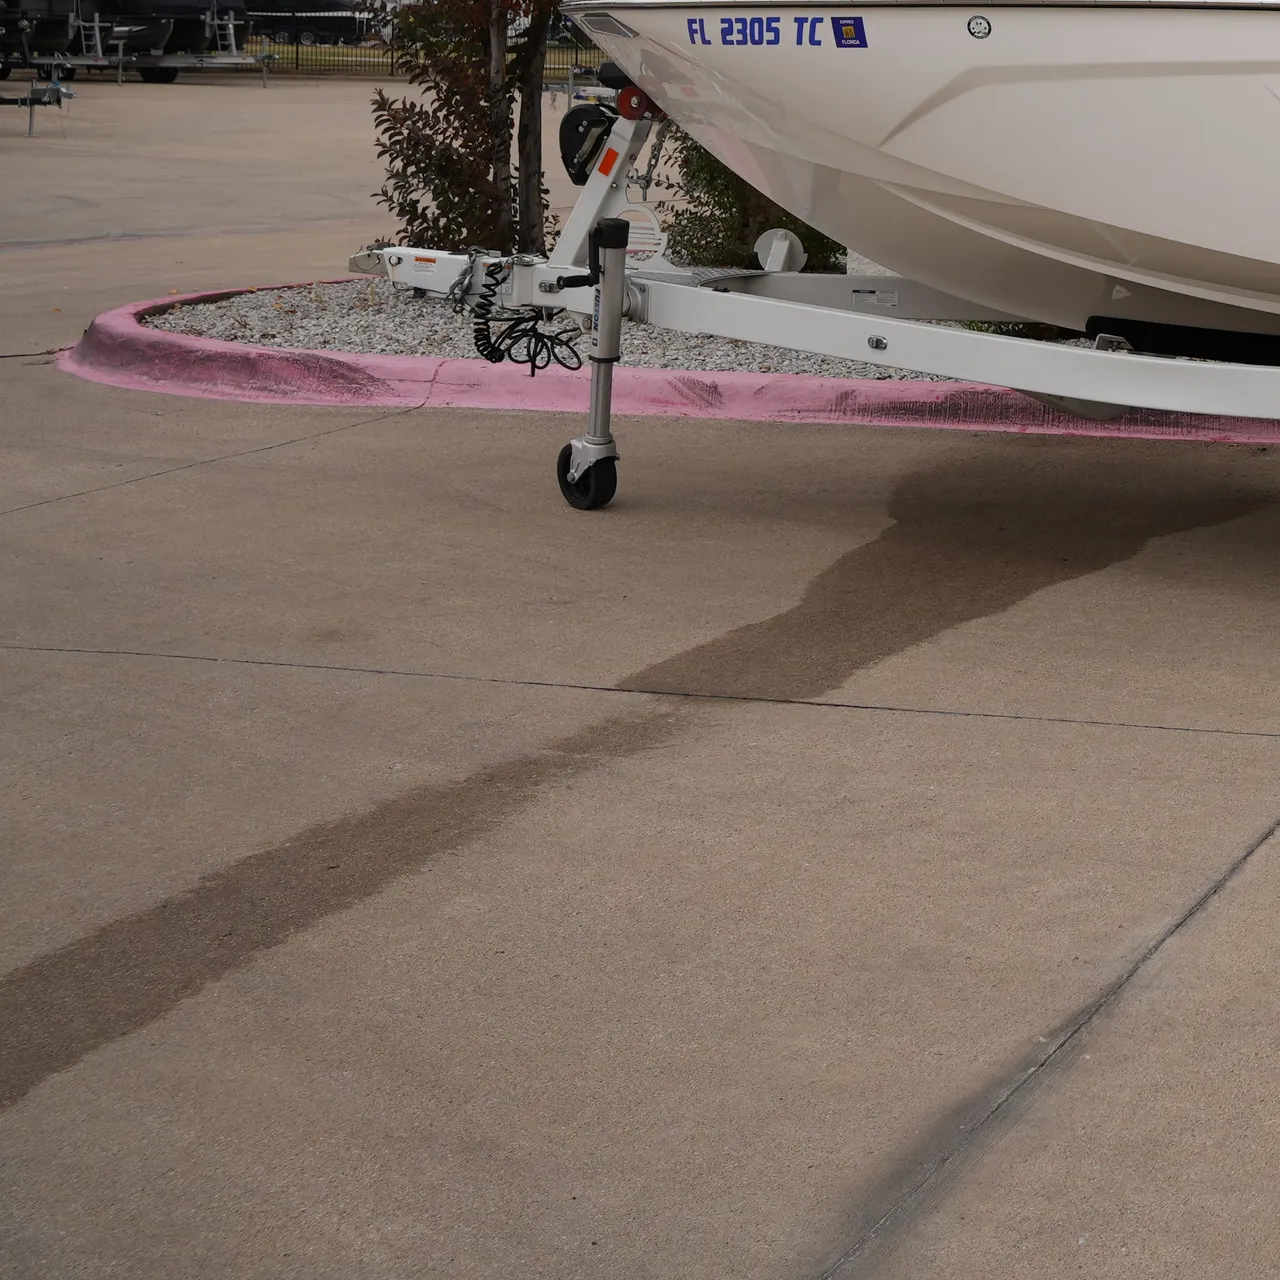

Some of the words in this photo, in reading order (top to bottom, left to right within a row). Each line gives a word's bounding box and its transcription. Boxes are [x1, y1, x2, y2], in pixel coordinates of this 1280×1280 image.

[686, 18, 712, 45] FL
[720, 16, 781, 46] 2305
[793, 16, 824, 46] TC
[593, 288, 601, 332] FULTON
